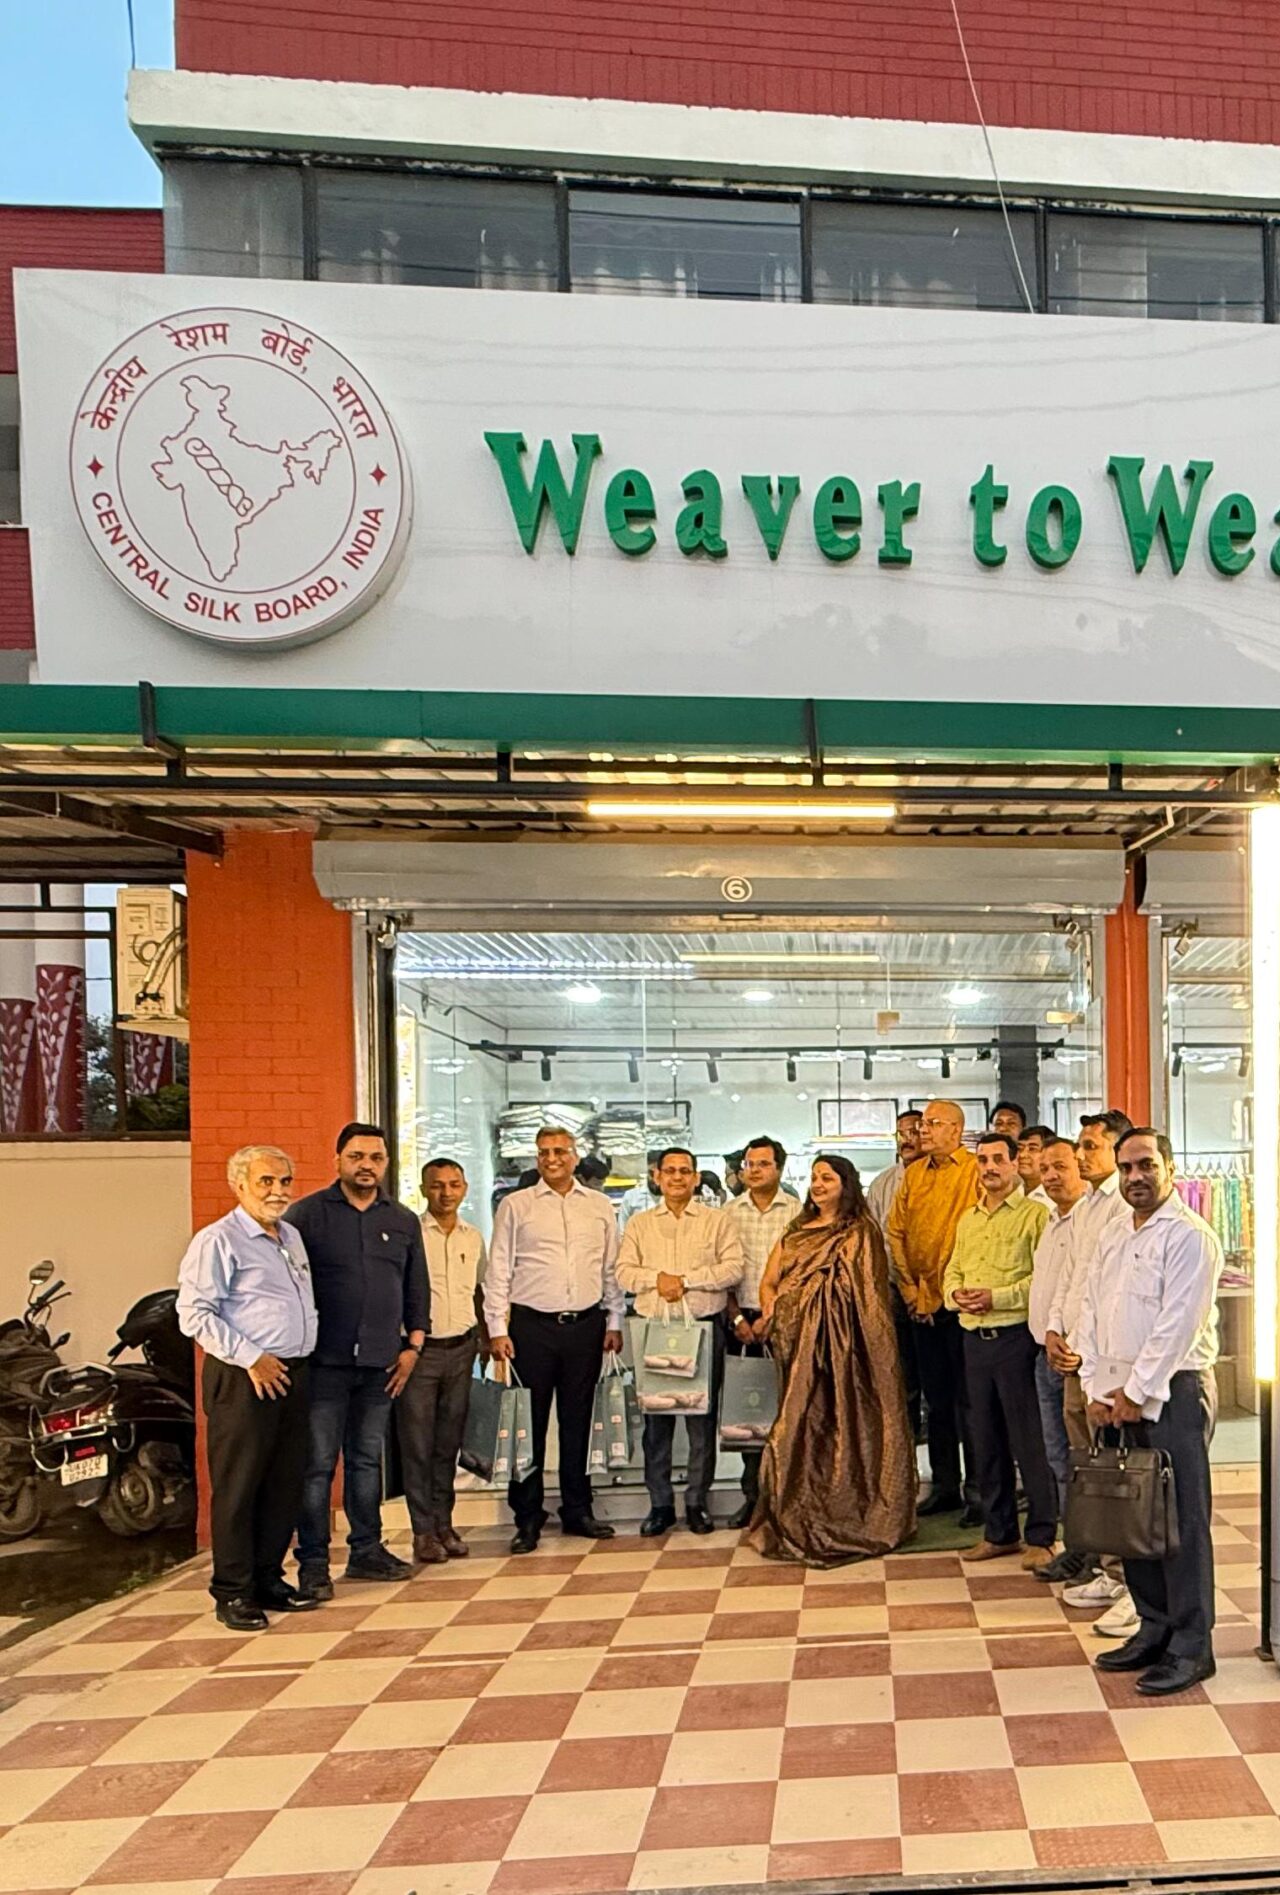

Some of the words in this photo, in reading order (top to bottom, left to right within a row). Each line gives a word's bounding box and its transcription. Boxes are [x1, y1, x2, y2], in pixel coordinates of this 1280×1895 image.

[160, 322, 230, 351] रेशम
[332, 376, 379, 439] भारत
[92, 492, 170, 600] CENTRAL
[184, 592, 241, 624] SILK
[341, 507, 384, 570] INDIA
[483, 430, 922, 566] Weaver
[969, 463, 1083, 570] to
